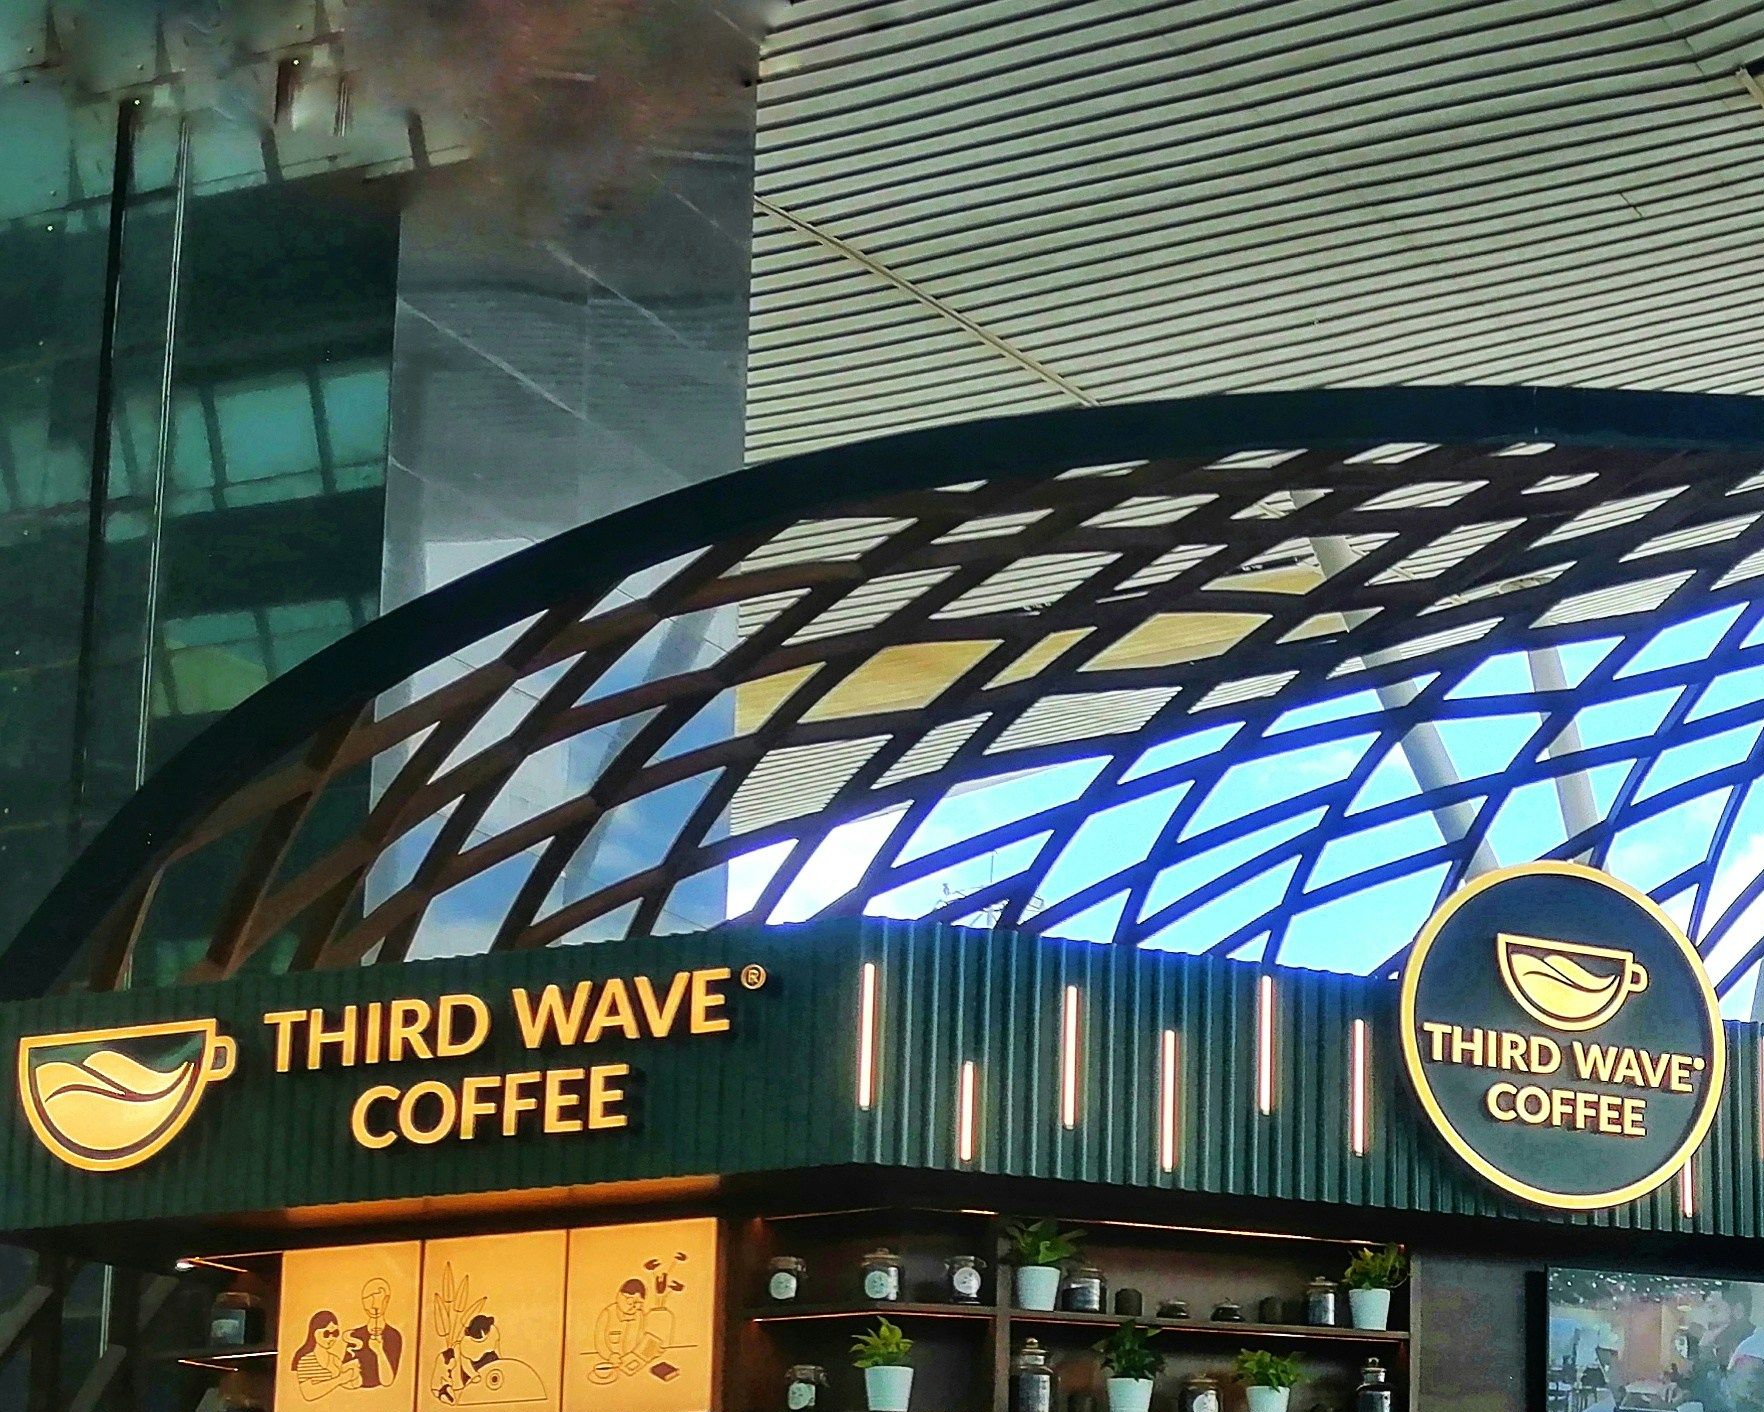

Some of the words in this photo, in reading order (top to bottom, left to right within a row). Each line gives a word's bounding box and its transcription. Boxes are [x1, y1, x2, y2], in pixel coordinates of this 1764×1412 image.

[264, 994, 489, 1072] THIRD
[1423, 1022, 1562, 1074] THIRD
[352, 1064, 629, 1149] COFFEE
[1487, 1082, 1647, 1136] COFFEE
